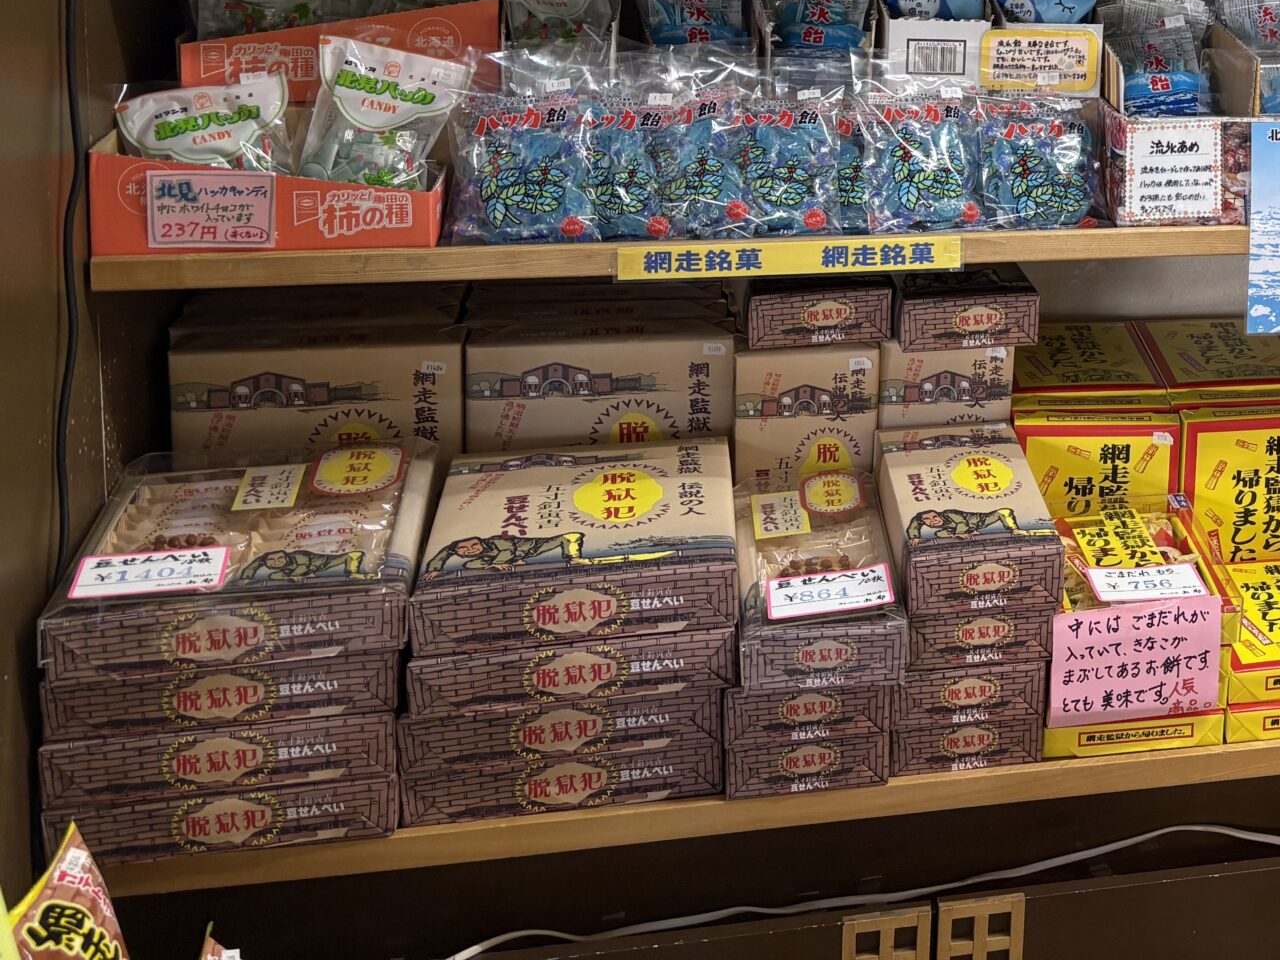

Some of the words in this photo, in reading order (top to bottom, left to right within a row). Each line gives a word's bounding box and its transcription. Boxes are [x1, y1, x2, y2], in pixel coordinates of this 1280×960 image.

[414, 36, 454, 48] 北海道
[336, 68, 436, 106] 北見ハッカ
[361, 97, 400, 114] CANDY
[154, 103, 261, 143] 北見ハッカ
[191, 128, 233, 146] CANDY
[1149, 140, 1200, 155] 流氷あめ
[156, 180, 198, 202] 北見
[205, 213, 254, 224] 入っています
[324, 202, 414, 237] 柿の種
[161, 221, 217, 240] 237円
[644, 248, 762, 274] 網走銘菓
[822, 242, 935, 268] 網走銘菓
[618, 422, 649, 444] 脱
[816, 444, 840, 463] 脱
[678, 481, 706, 516] 伝説の人
[1230, 468, 1263, 561] 帰りました
[94, 565, 193, 582] ¥1404
[784, 586, 849, 603] ¥864
[1106, 579, 1173, 590] ¥756
[535, 599, 613, 626] 脱獄犯
[630, 596, 684, 610] 豆せんべい
[1068, 615, 1122, 639] 中には
[1132, 606, 1210, 630] ごまだれが
[174, 624, 264, 653] 脱獄犯
[1065, 642, 1127, 662] 入っていて、
[1133, 636, 1188, 652] きなこが
[535, 662, 612, 688] 脱獄犯
[630, 659, 684, 673] 豆せんべい
[1169, 678, 1198, 698] 人気
[1062, 696, 1094, 713] とても
[522, 718, 598, 745] 脱獄犯
[615, 714, 670, 729] 豆せんべい
[1086, 729, 1186, 742] 網走監獄から帰りました。
[620, 766, 673, 781] 豆せんべい
[527, 771, 602, 798] 脱獄犯
